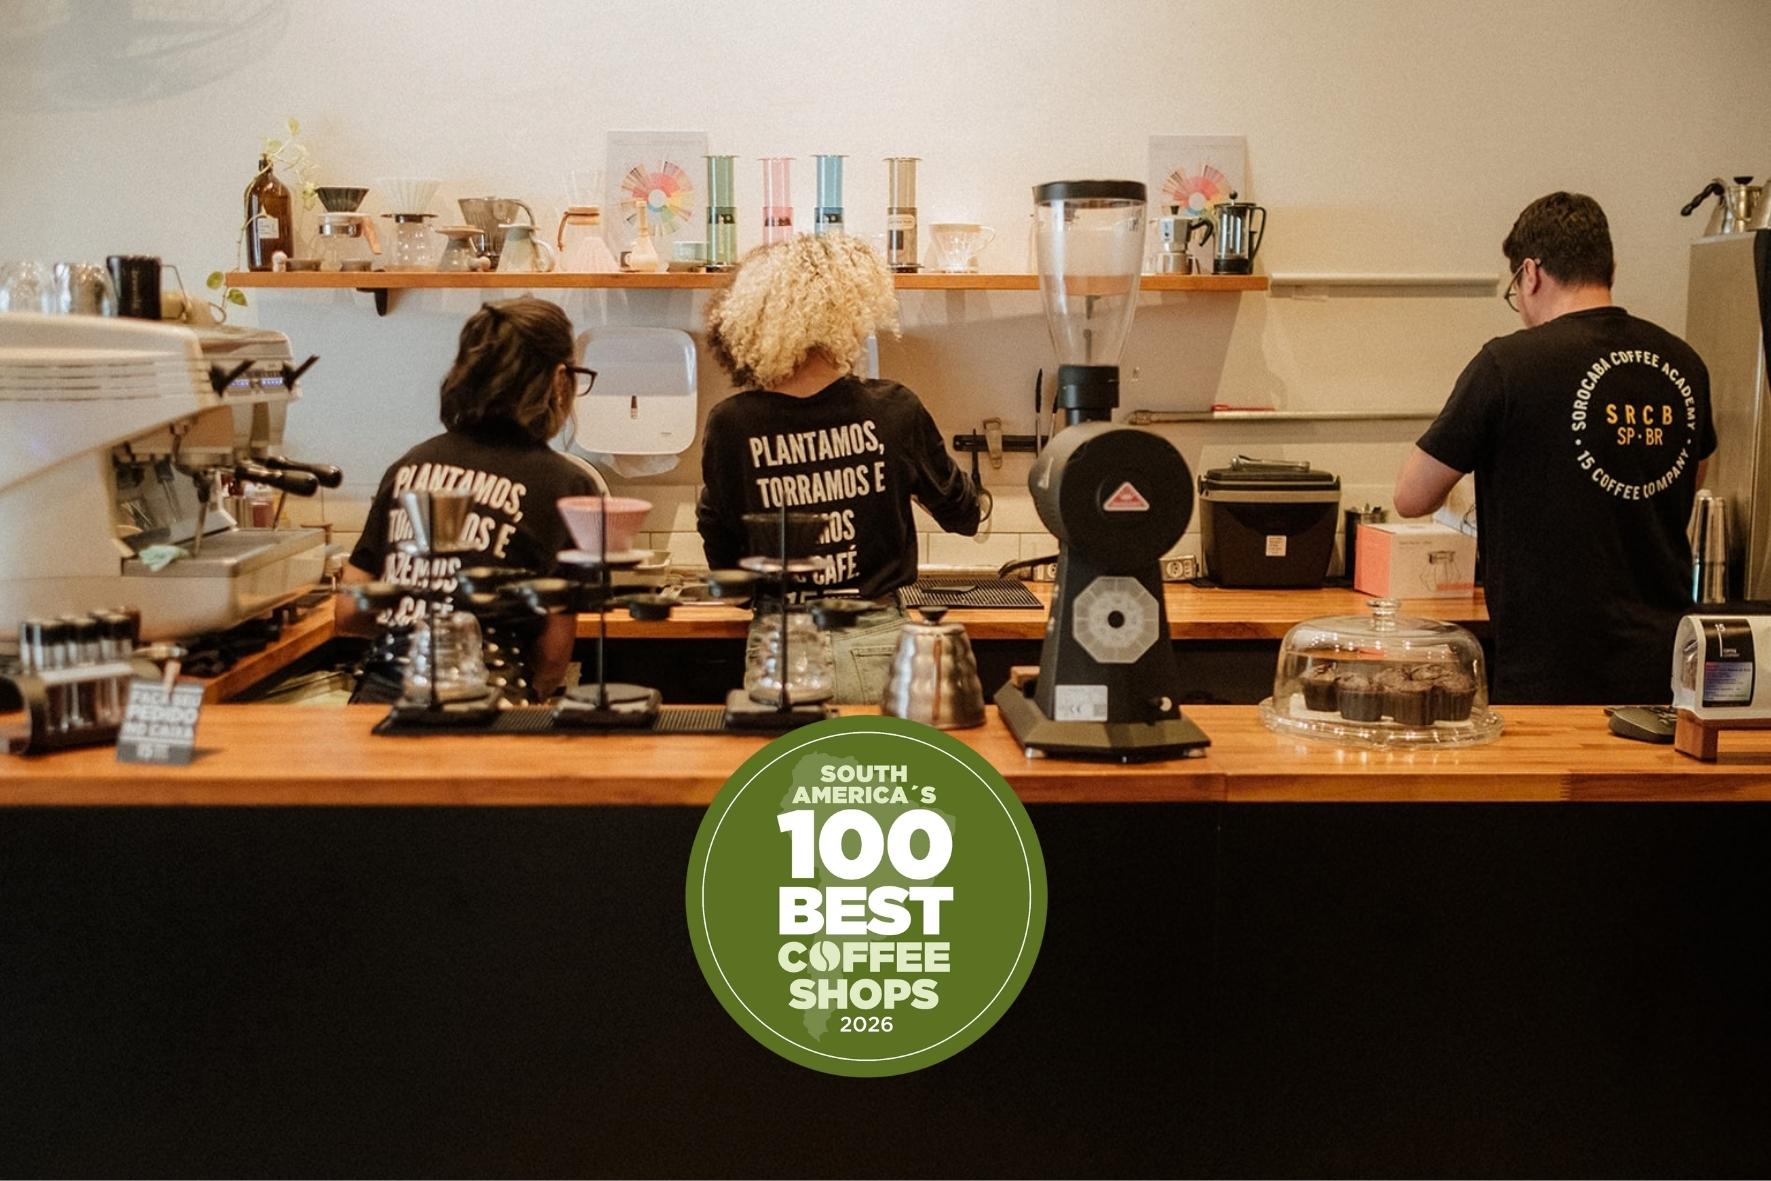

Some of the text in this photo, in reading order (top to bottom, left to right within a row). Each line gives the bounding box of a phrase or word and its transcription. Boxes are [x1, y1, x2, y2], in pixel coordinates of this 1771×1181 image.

[1571, 350, 1696, 432] SOROCABA COFFEE ACADEMY
[749, 420, 885, 468] PLANTAMOS,
[756, 461, 886, 509] TORRAMOS E
[1577, 448, 1689, 500] 15 COFFEE COMPANY
[493, 523, 517, 559] E
